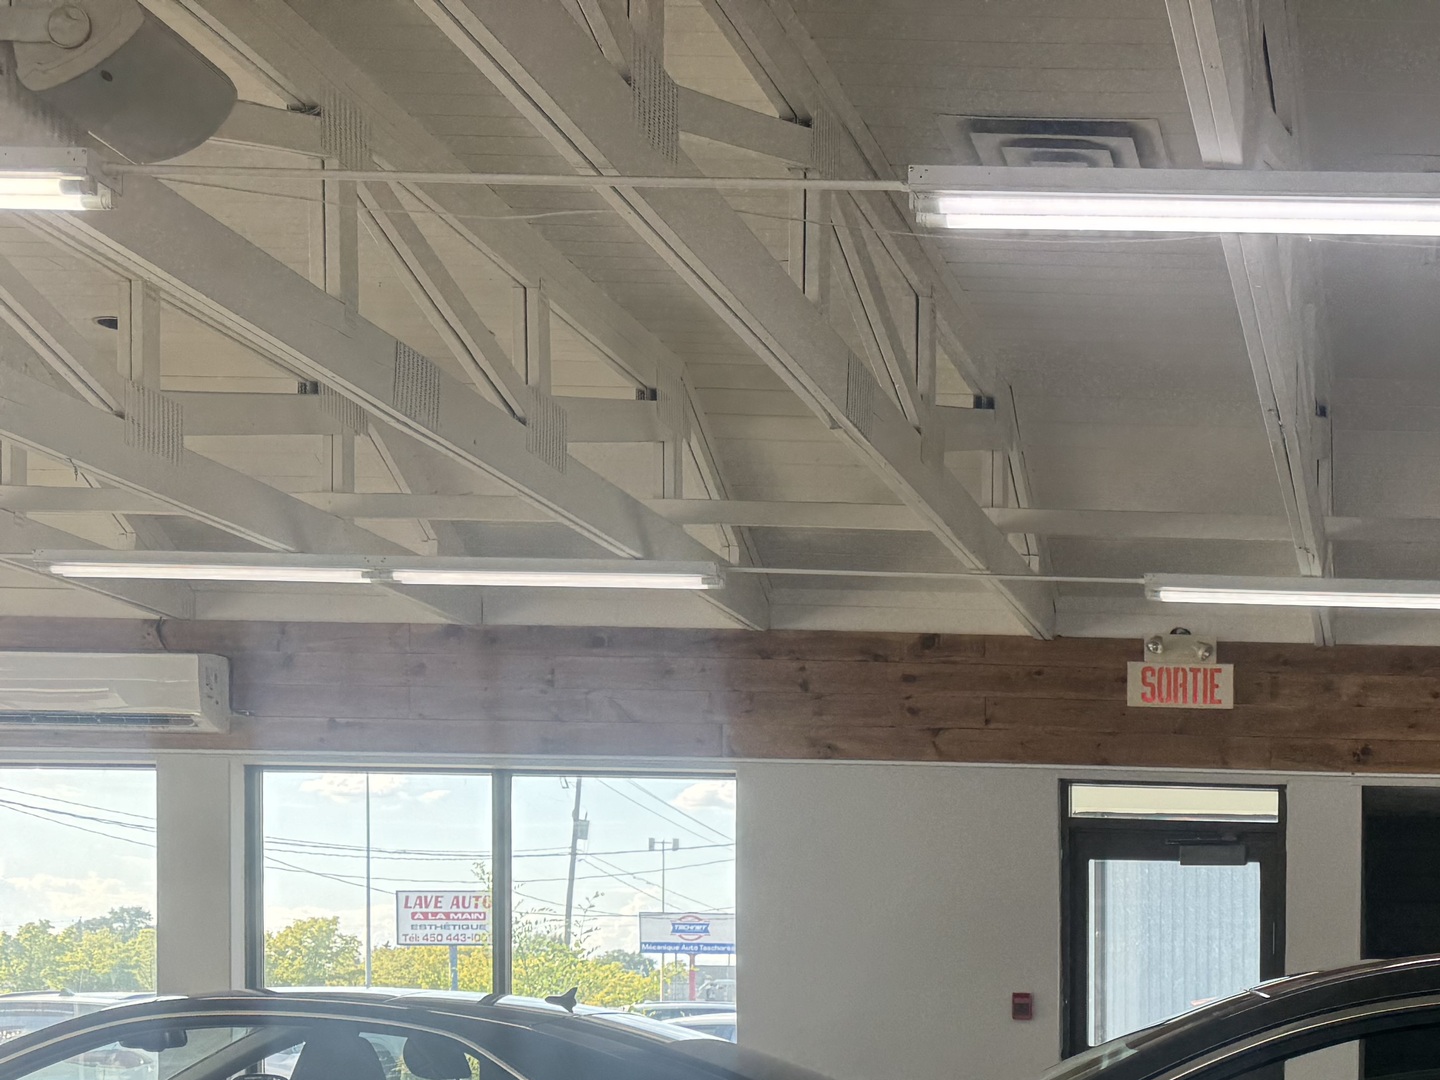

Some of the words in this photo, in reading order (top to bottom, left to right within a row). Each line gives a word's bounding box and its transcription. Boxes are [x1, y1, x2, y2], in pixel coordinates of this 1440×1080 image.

[1141, 666, 1222, 704] SORTIE
[403, 895, 444, 909] LAVE
[450, 895, 492, 909] AUTO
[402, 933, 420, 942] Tél:
[422, 934, 443, 942] 450
